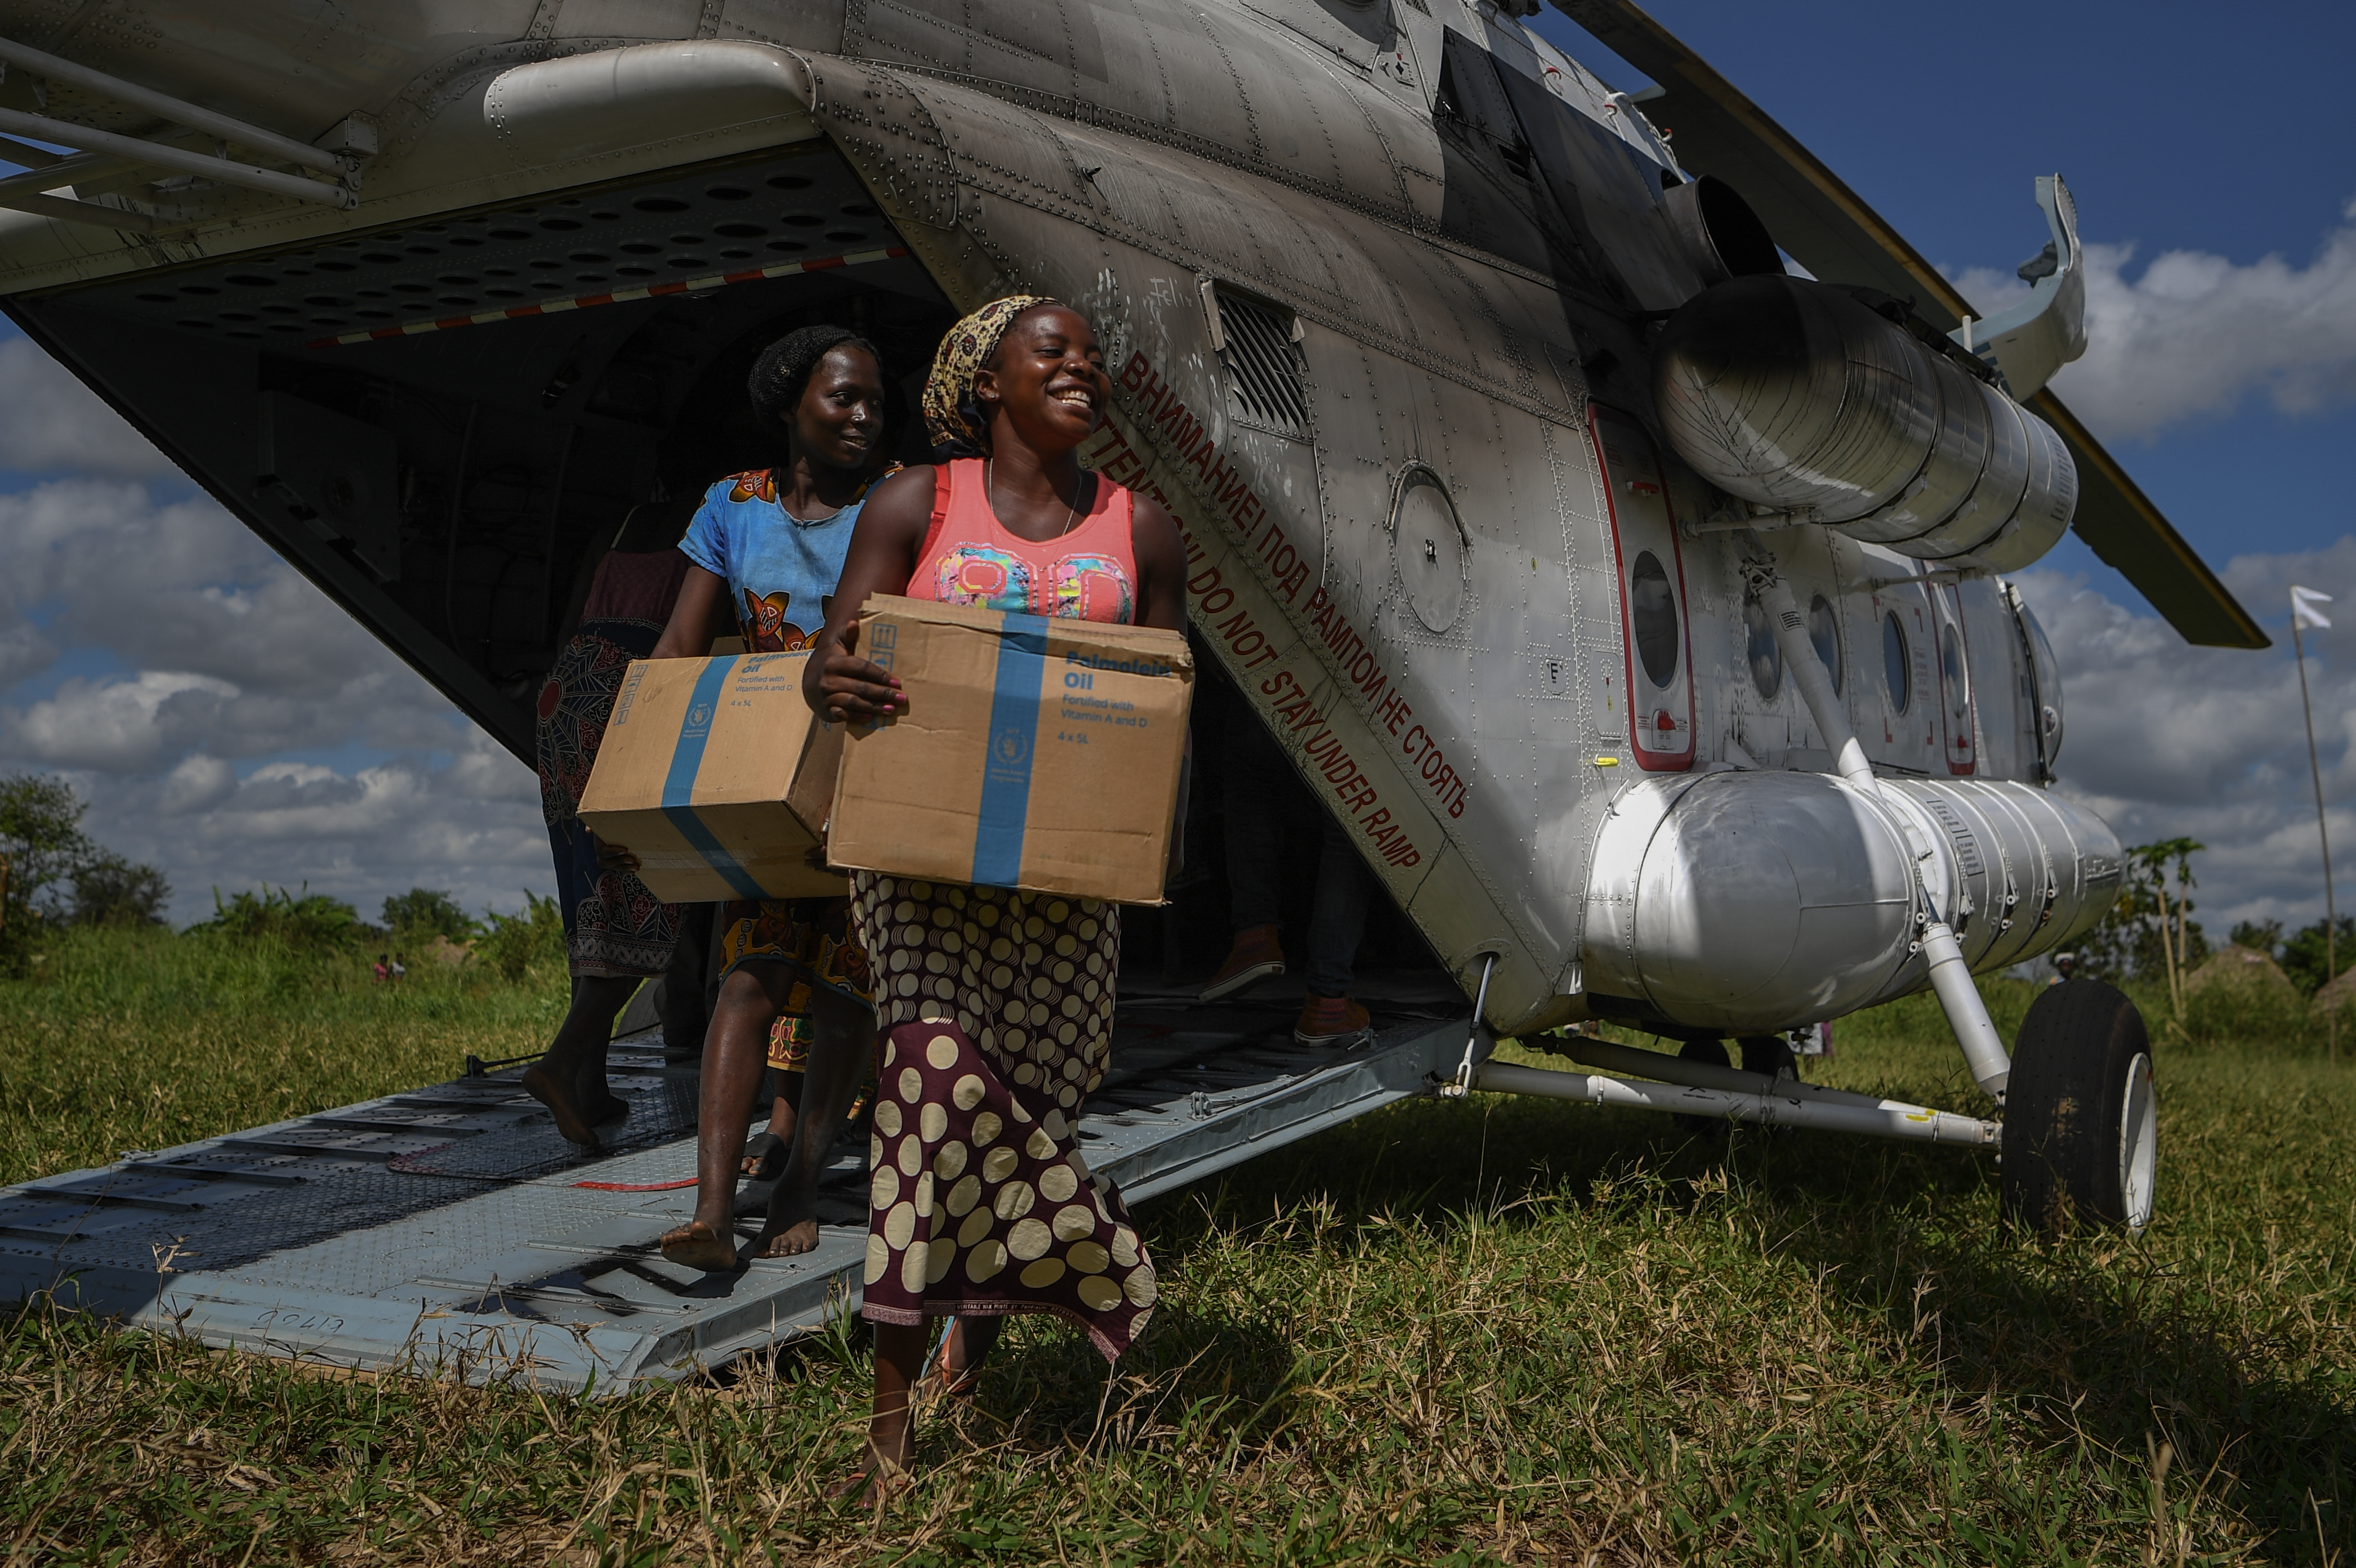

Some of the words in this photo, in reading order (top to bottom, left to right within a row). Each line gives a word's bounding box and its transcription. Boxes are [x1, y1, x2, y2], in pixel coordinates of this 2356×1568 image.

[1149, 276, 1193, 308] Felix
[1120, 350, 1266, 537] ВНИМАНИЕ!
[1257, 522, 1311, 604] ПОД
[1377, 685, 1412, 736] НЕ
[1403, 725, 1468, 819] СТОЯТЬ
[741, 664, 762, 673] Oil
[1064, 672, 1094, 690] Oil
[1063, 694, 1109, 710] Fortified
[1110, 700, 1134, 712] with
[1061, 709, 1103, 722] Vitamin
[1104, 713, 1113, 724] A
[1115, 715, 1136, 727] and
[1139, 717, 1148, 728] D
[1188, 566, 1235, 614] DO
[1216, 610, 1279, 669] NOT
[1261, 670, 1325, 733] STAY
[1304, 729, 1377, 815] UNDER
[1359, 806, 1421, 868] RAMP
[1057, 731, 1065, 740] 4
[1077, 732, 1089, 744] 5L
